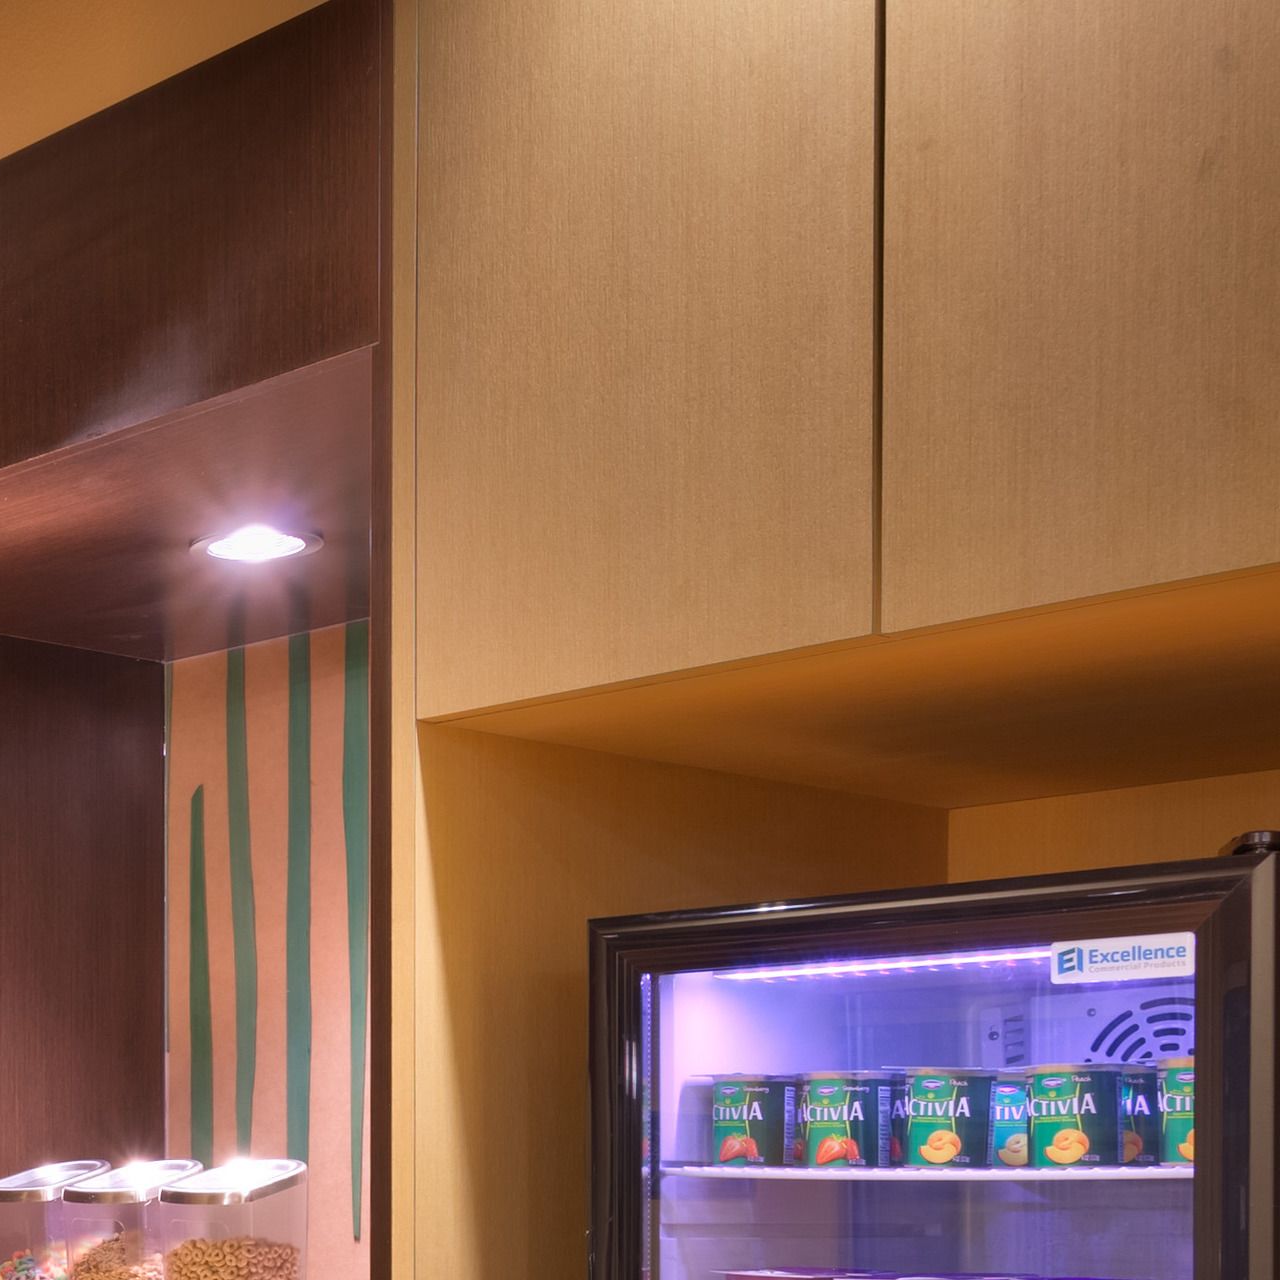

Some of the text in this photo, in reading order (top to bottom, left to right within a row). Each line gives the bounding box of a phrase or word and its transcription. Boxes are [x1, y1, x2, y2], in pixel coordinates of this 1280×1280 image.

[1089, 945, 1186, 964] Excellence
[1089, 960, 1187, 974] Commercial Products
[713, 1101, 764, 1121] CTIVIA
